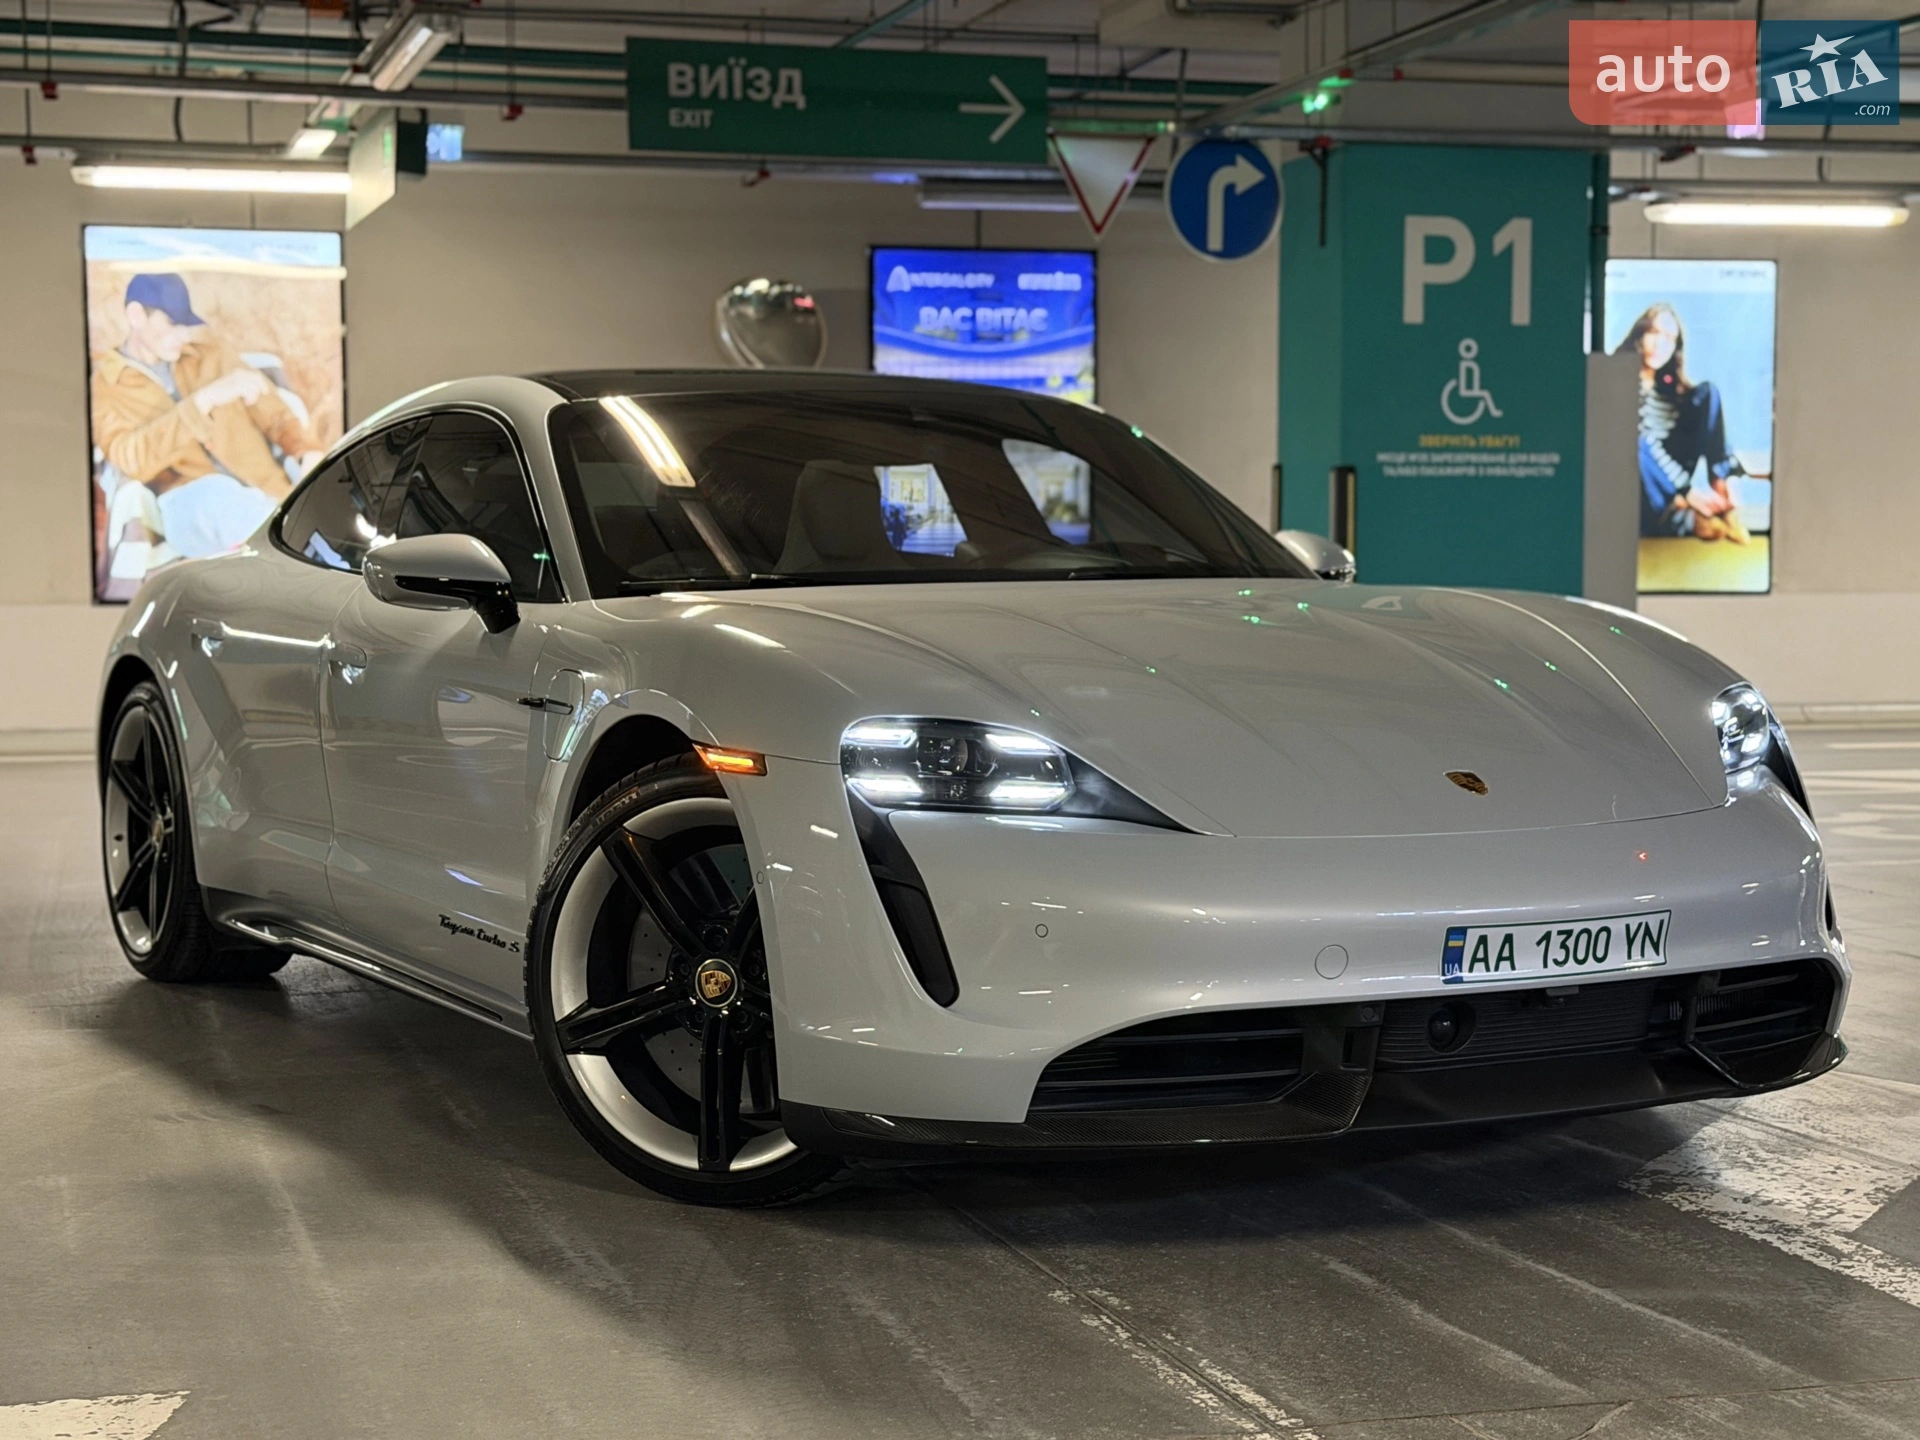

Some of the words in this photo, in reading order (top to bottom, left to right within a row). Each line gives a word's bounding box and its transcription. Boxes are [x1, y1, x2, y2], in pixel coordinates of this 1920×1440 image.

[667, 57, 806, 110] ВИЇЗД
[668, 107, 713, 128] EXIT
[1403, 215, 1533, 326] P1
[508, 941, 520, 953] S
[1468, 933, 1517, 973] AA
[1535, 925, 1612, 969] 1300
[1624, 918, 1665, 960] YN
[1444, 962, 1461, 976] UA
